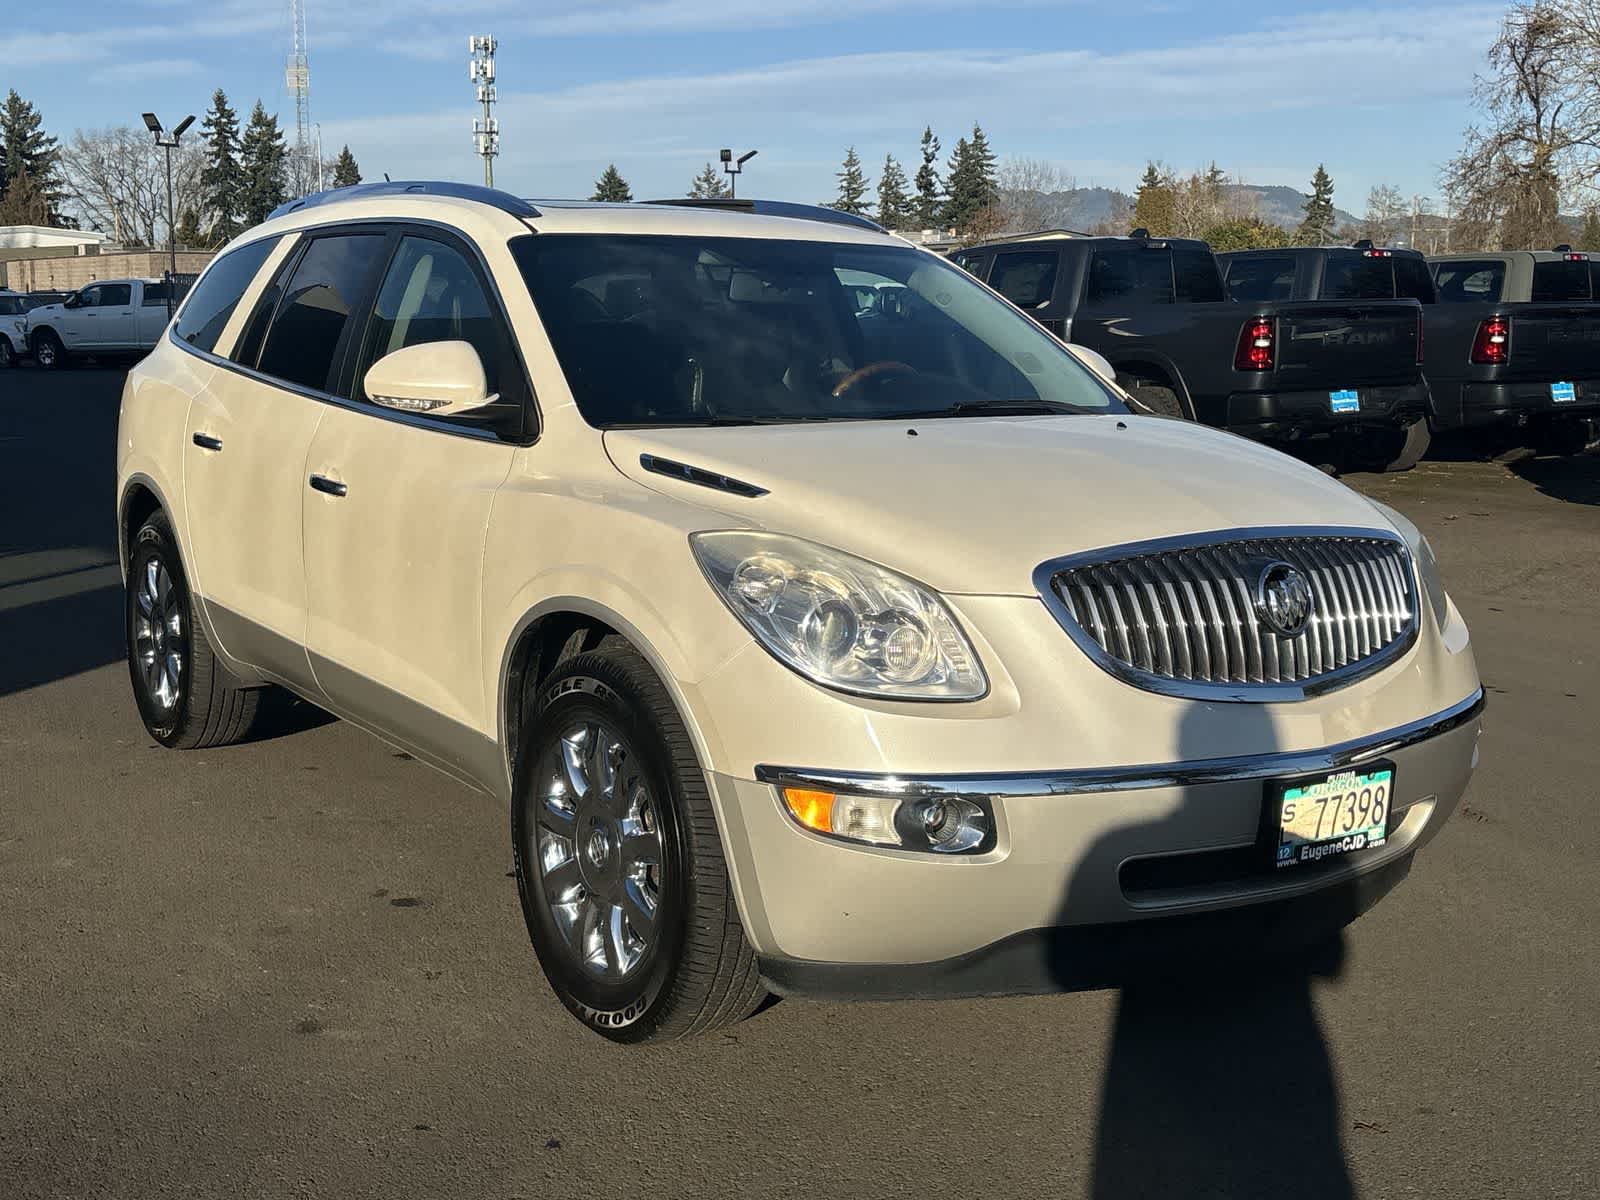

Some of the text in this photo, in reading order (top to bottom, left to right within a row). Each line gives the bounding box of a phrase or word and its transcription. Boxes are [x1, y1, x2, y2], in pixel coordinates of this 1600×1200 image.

[1322, 327, 1389, 345] RAM
[1282, 785, 1385, 838] S 77398
[1279, 847, 1290, 859] 12
[1301, 834, 1366, 860] EugeneCJD
